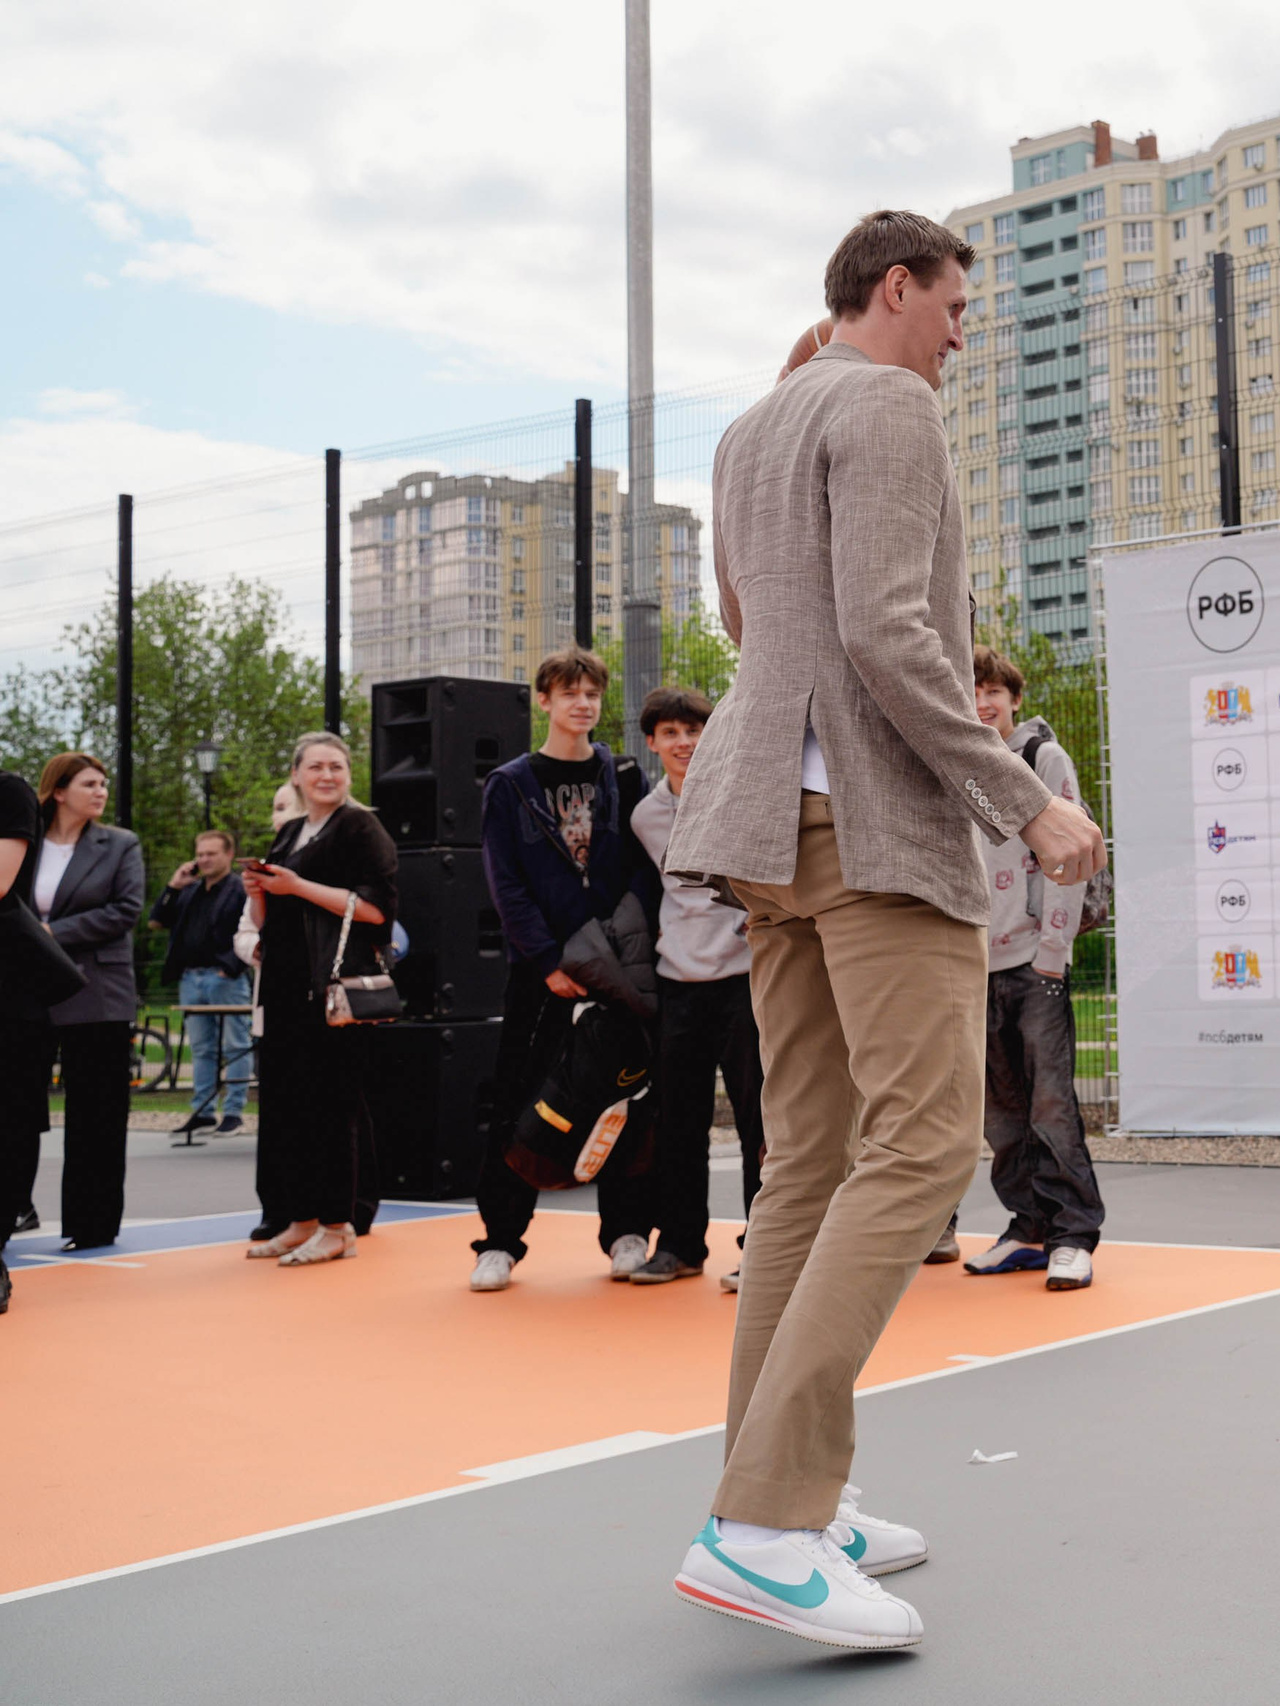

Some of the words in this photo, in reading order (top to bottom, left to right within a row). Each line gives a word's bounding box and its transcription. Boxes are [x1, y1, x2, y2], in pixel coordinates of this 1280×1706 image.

[1197, 589, 1255, 620] РФБ
[1217, 763, 1242, 776] РФБ
[1220, 894, 1246, 907] РФБ
[1198, 1029, 1263, 1044] #псбдетям
